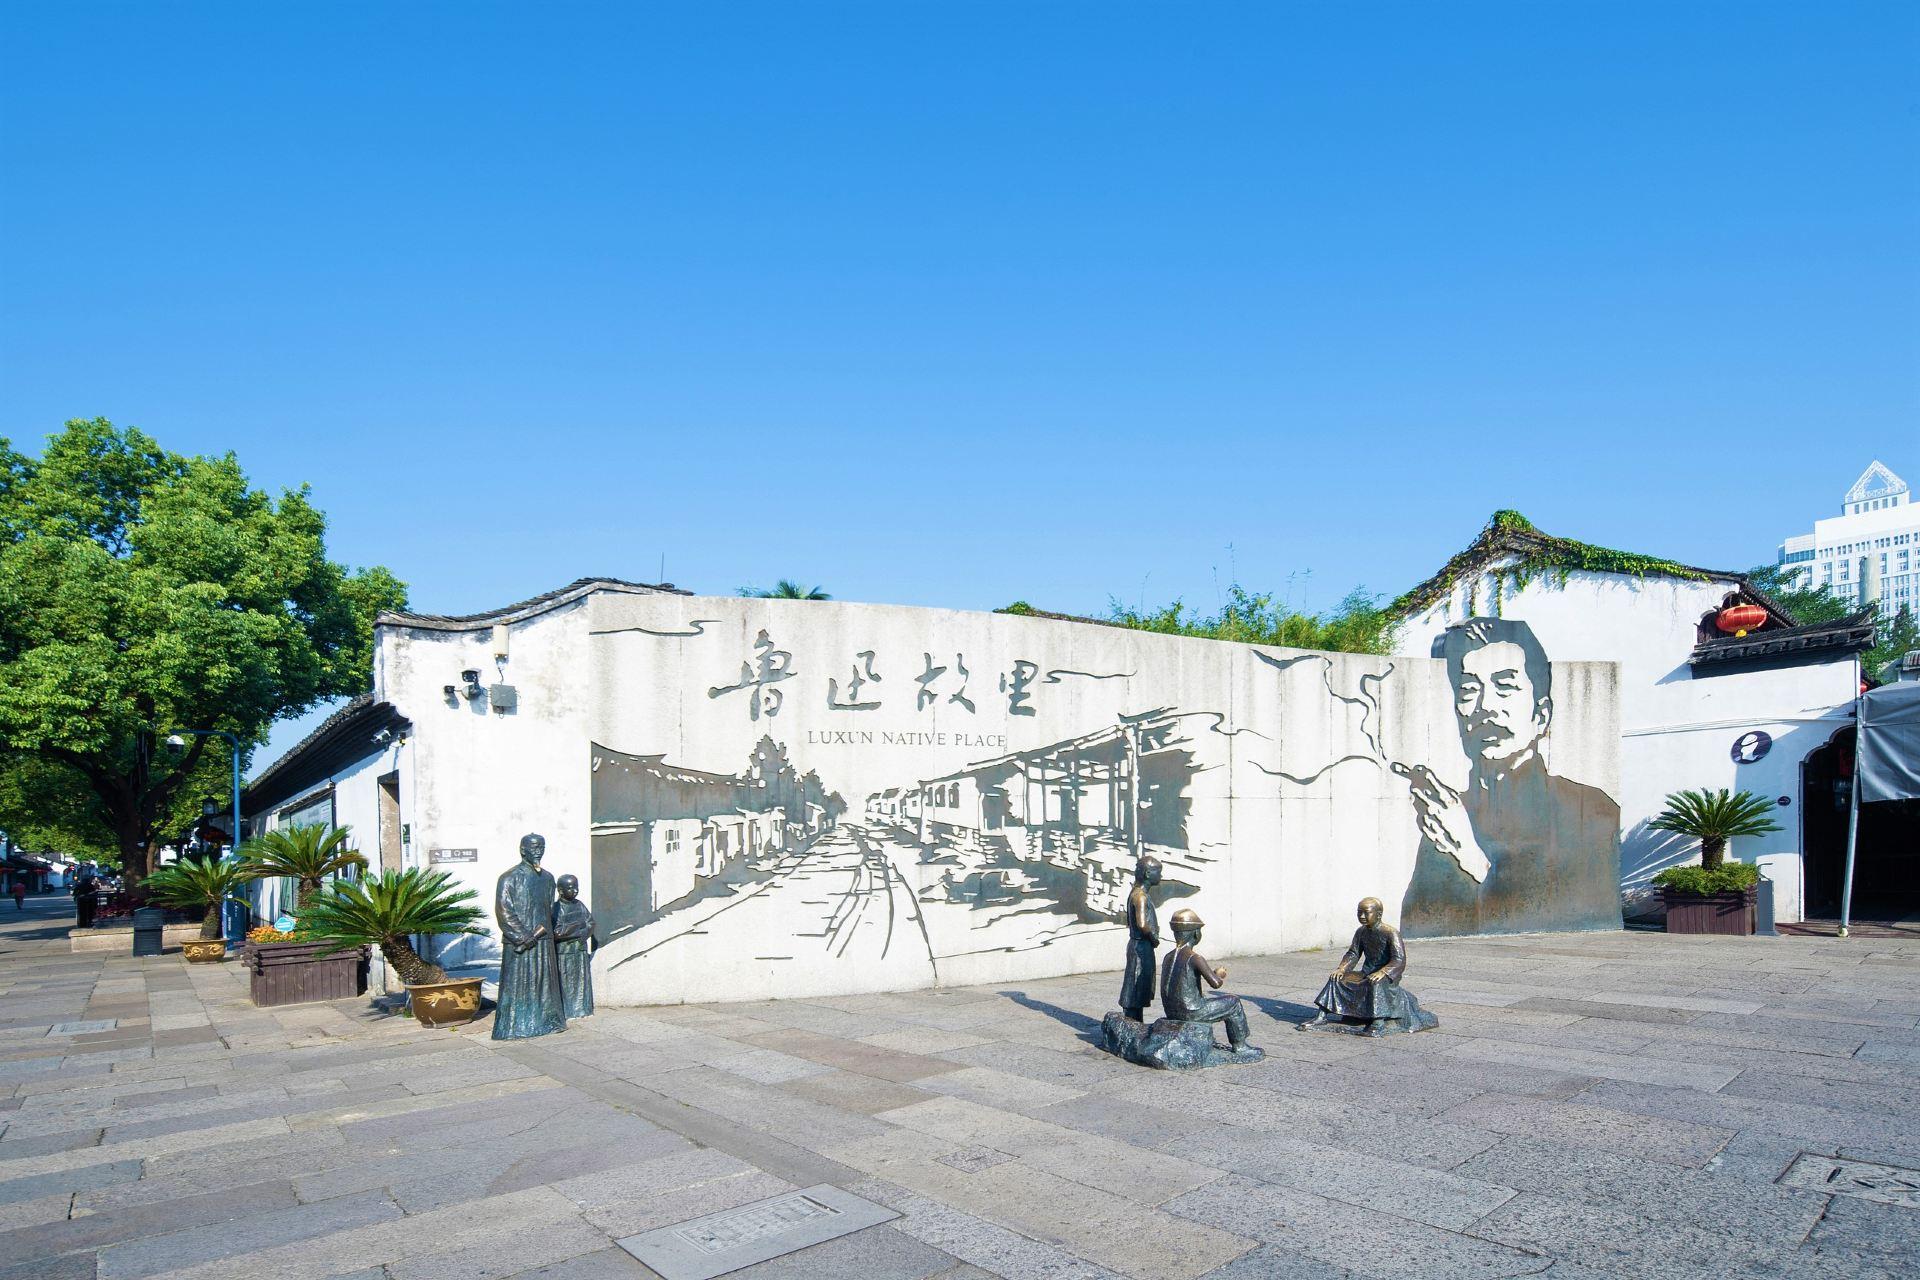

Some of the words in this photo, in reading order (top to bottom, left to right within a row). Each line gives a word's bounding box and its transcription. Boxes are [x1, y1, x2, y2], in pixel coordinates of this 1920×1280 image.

[708, 628, 1039, 722] 鲁迅故里
[808, 730, 873, 744] LUXUN
[882, 731, 947, 746] NATIVE
[954, 733, 1007, 747] PLACE
